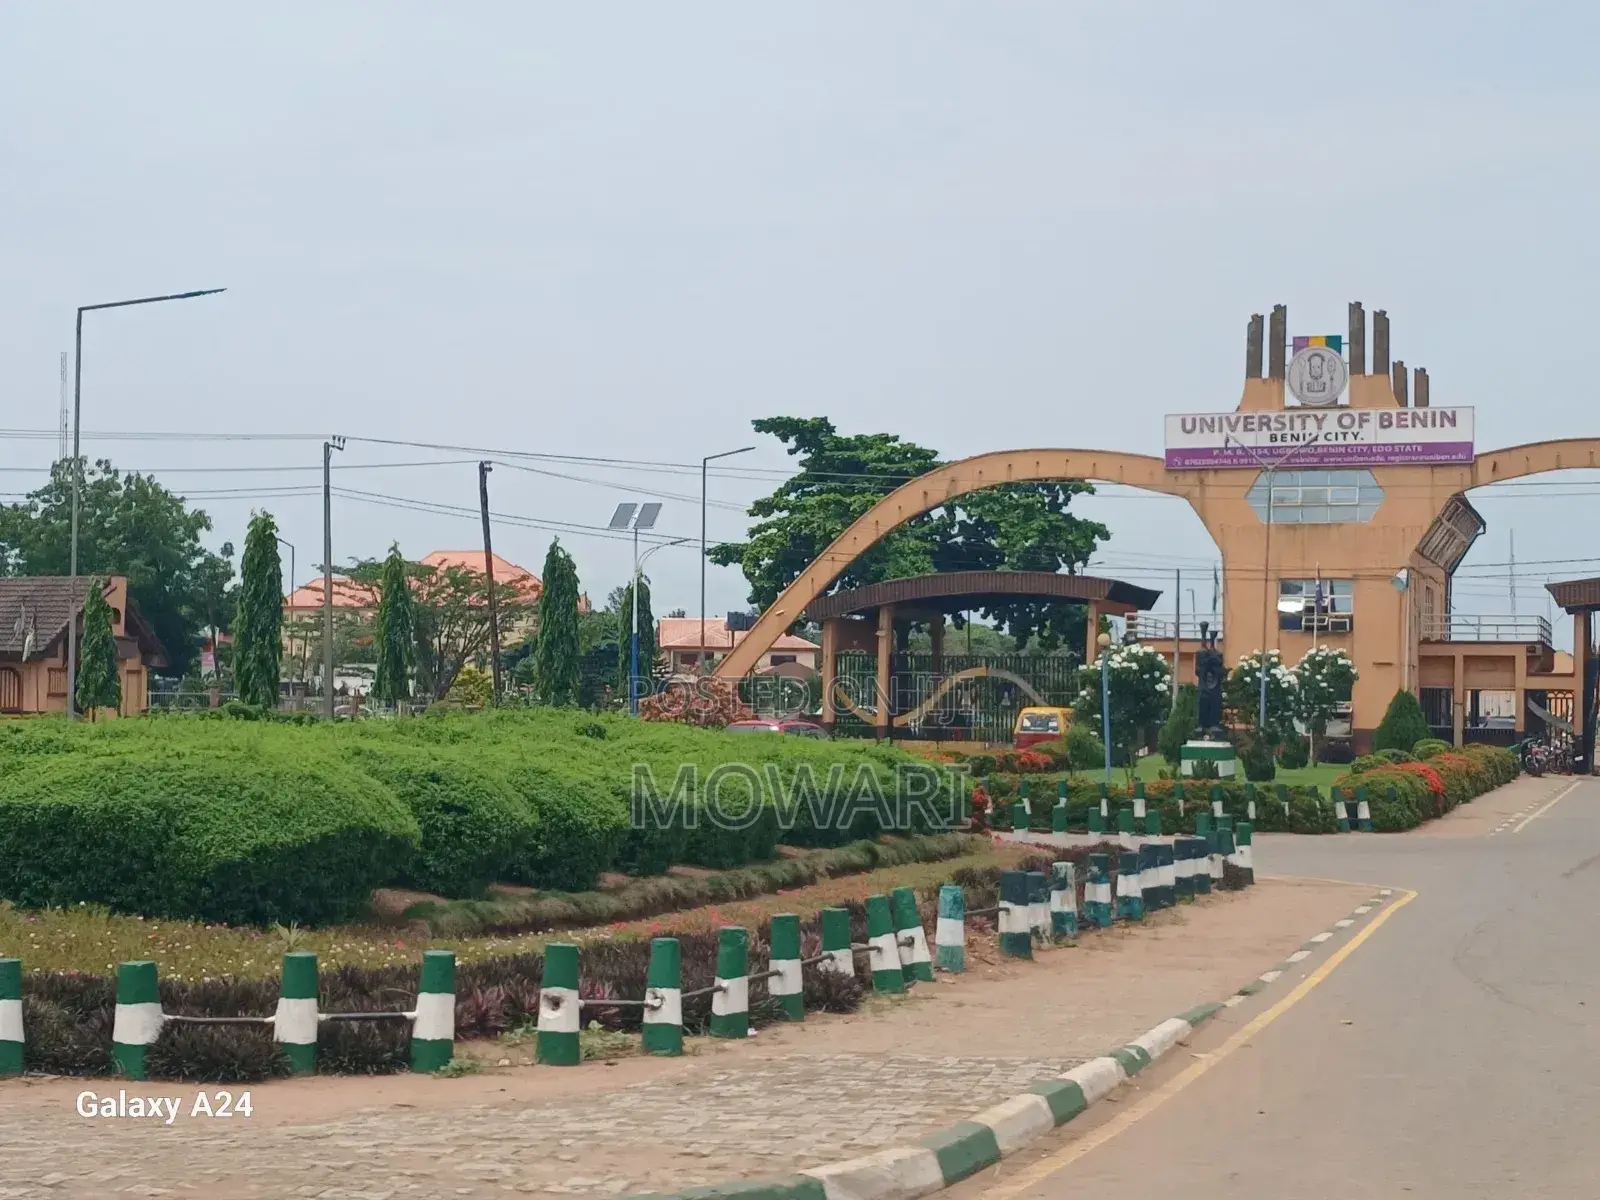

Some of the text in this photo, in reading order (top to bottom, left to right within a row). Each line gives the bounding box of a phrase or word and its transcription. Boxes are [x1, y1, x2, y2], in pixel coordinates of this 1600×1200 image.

[1181, 410, 1457, 434] UNIVERSITY OF BENIN
[1324, 431, 1364, 442] CITY.
[1373, 444, 1393, 453] EDO
[1394, 444, 1423, 453] STATE
